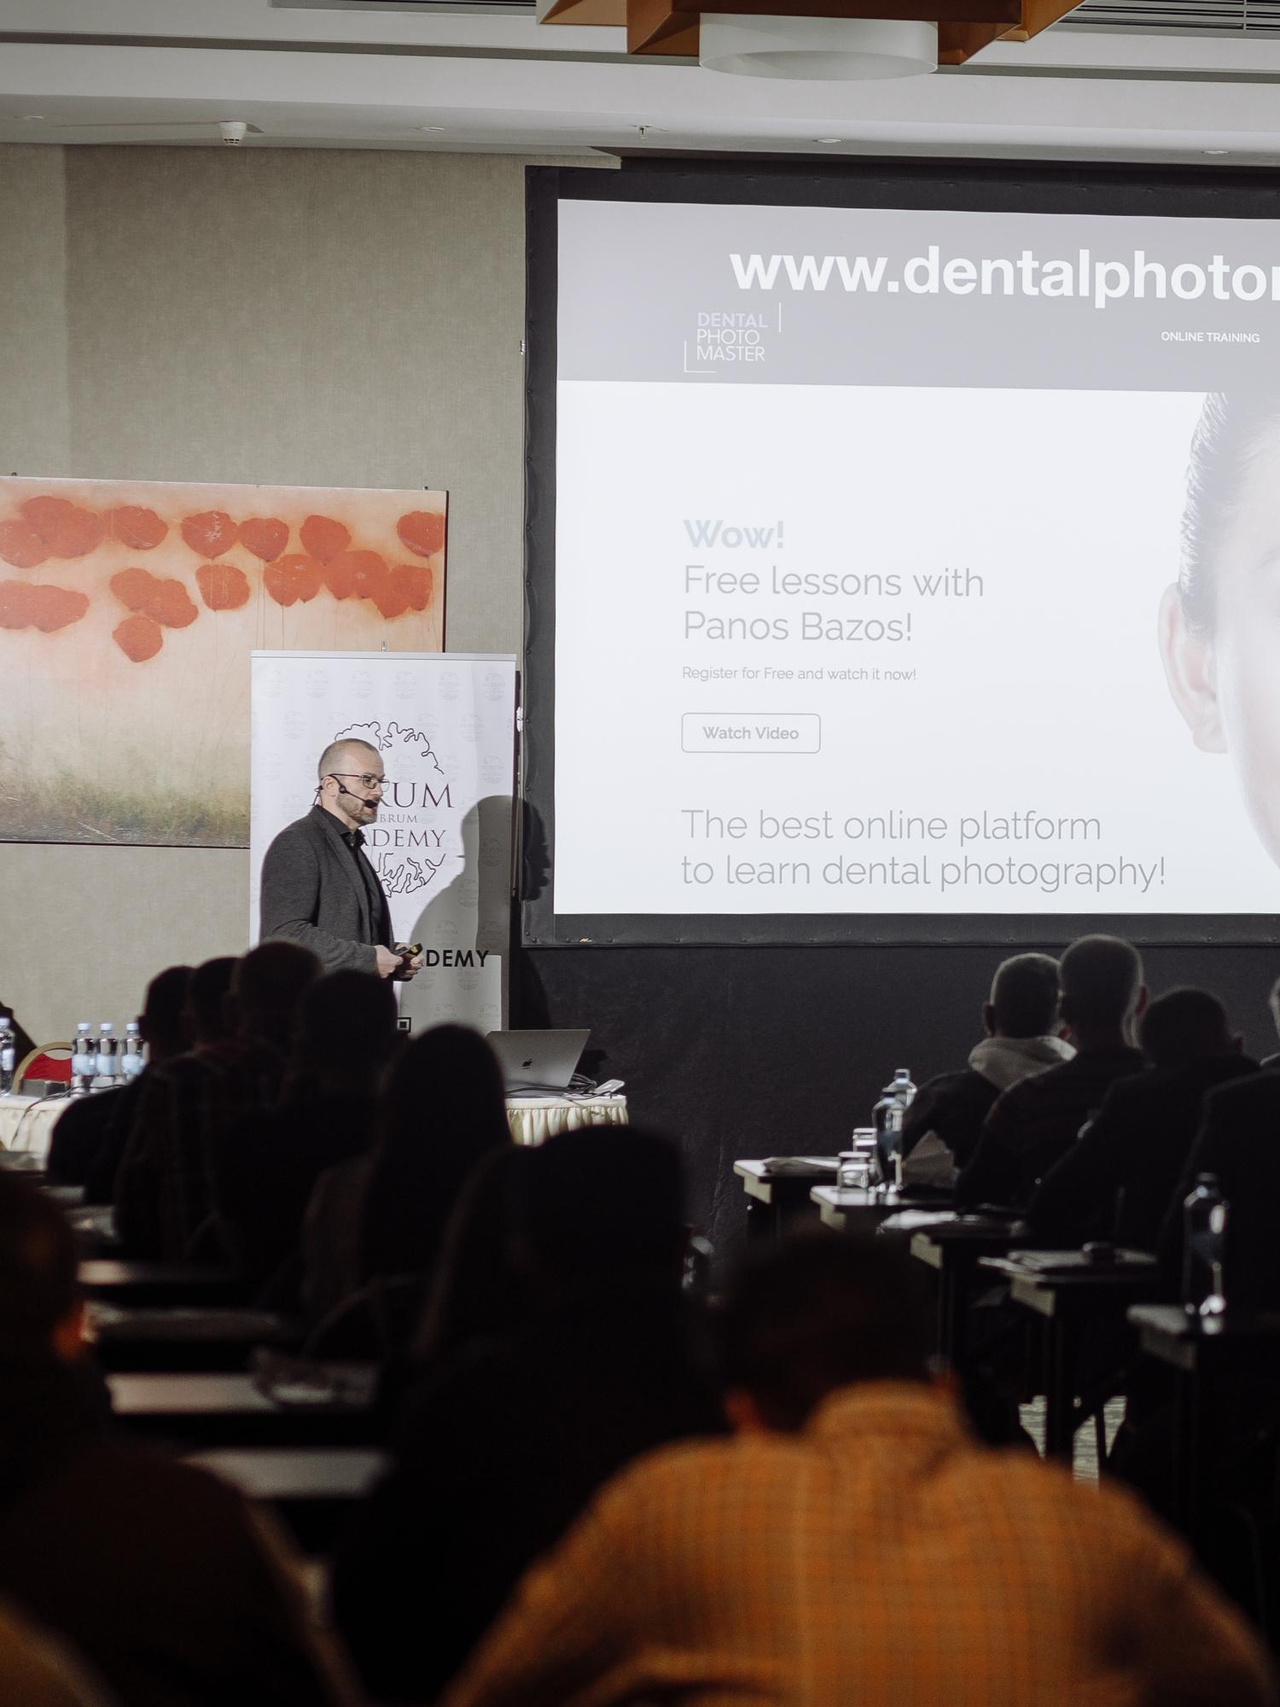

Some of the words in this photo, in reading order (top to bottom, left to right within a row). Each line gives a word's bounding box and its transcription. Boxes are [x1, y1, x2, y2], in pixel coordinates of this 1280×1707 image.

[697, 312, 768, 329] DENTAL
[697, 329, 760, 346] PHOTO
[1161, 331, 1203, 343] ONLINE
[1206, 332, 1261, 344] TRAINING
[697, 345, 766, 362] MASTER
[683, 519, 784, 549] Wow!
[685, 565, 760, 595] Free
[772, 565, 902, 597] lessons
[913, 567, 984, 597] with
[685, 610, 789, 641] Panos
[802, 611, 912, 642] Bazos!
[682, 666, 739, 683] Register
[742, 666, 760, 680] for
[764, 667, 794, 681] Free
[798, 667, 823, 681] and
[827, 668, 868, 681] watch
[872, 668, 880, 681] it
[883, 668, 917, 681] now!
[703, 725, 752, 740] Watch
[755, 726, 800, 740] Video
[681, 809, 748, 840] The
[760, 810, 833, 840] best
[844, 810, 948, 841] online
[960, 810, 1101, 848] platform
[681, 855, 714, 885] to
[727, 855, 811, 885] learn
[822, 855, 931, 885] dental
[941, 856, 1165, 894] photography!
